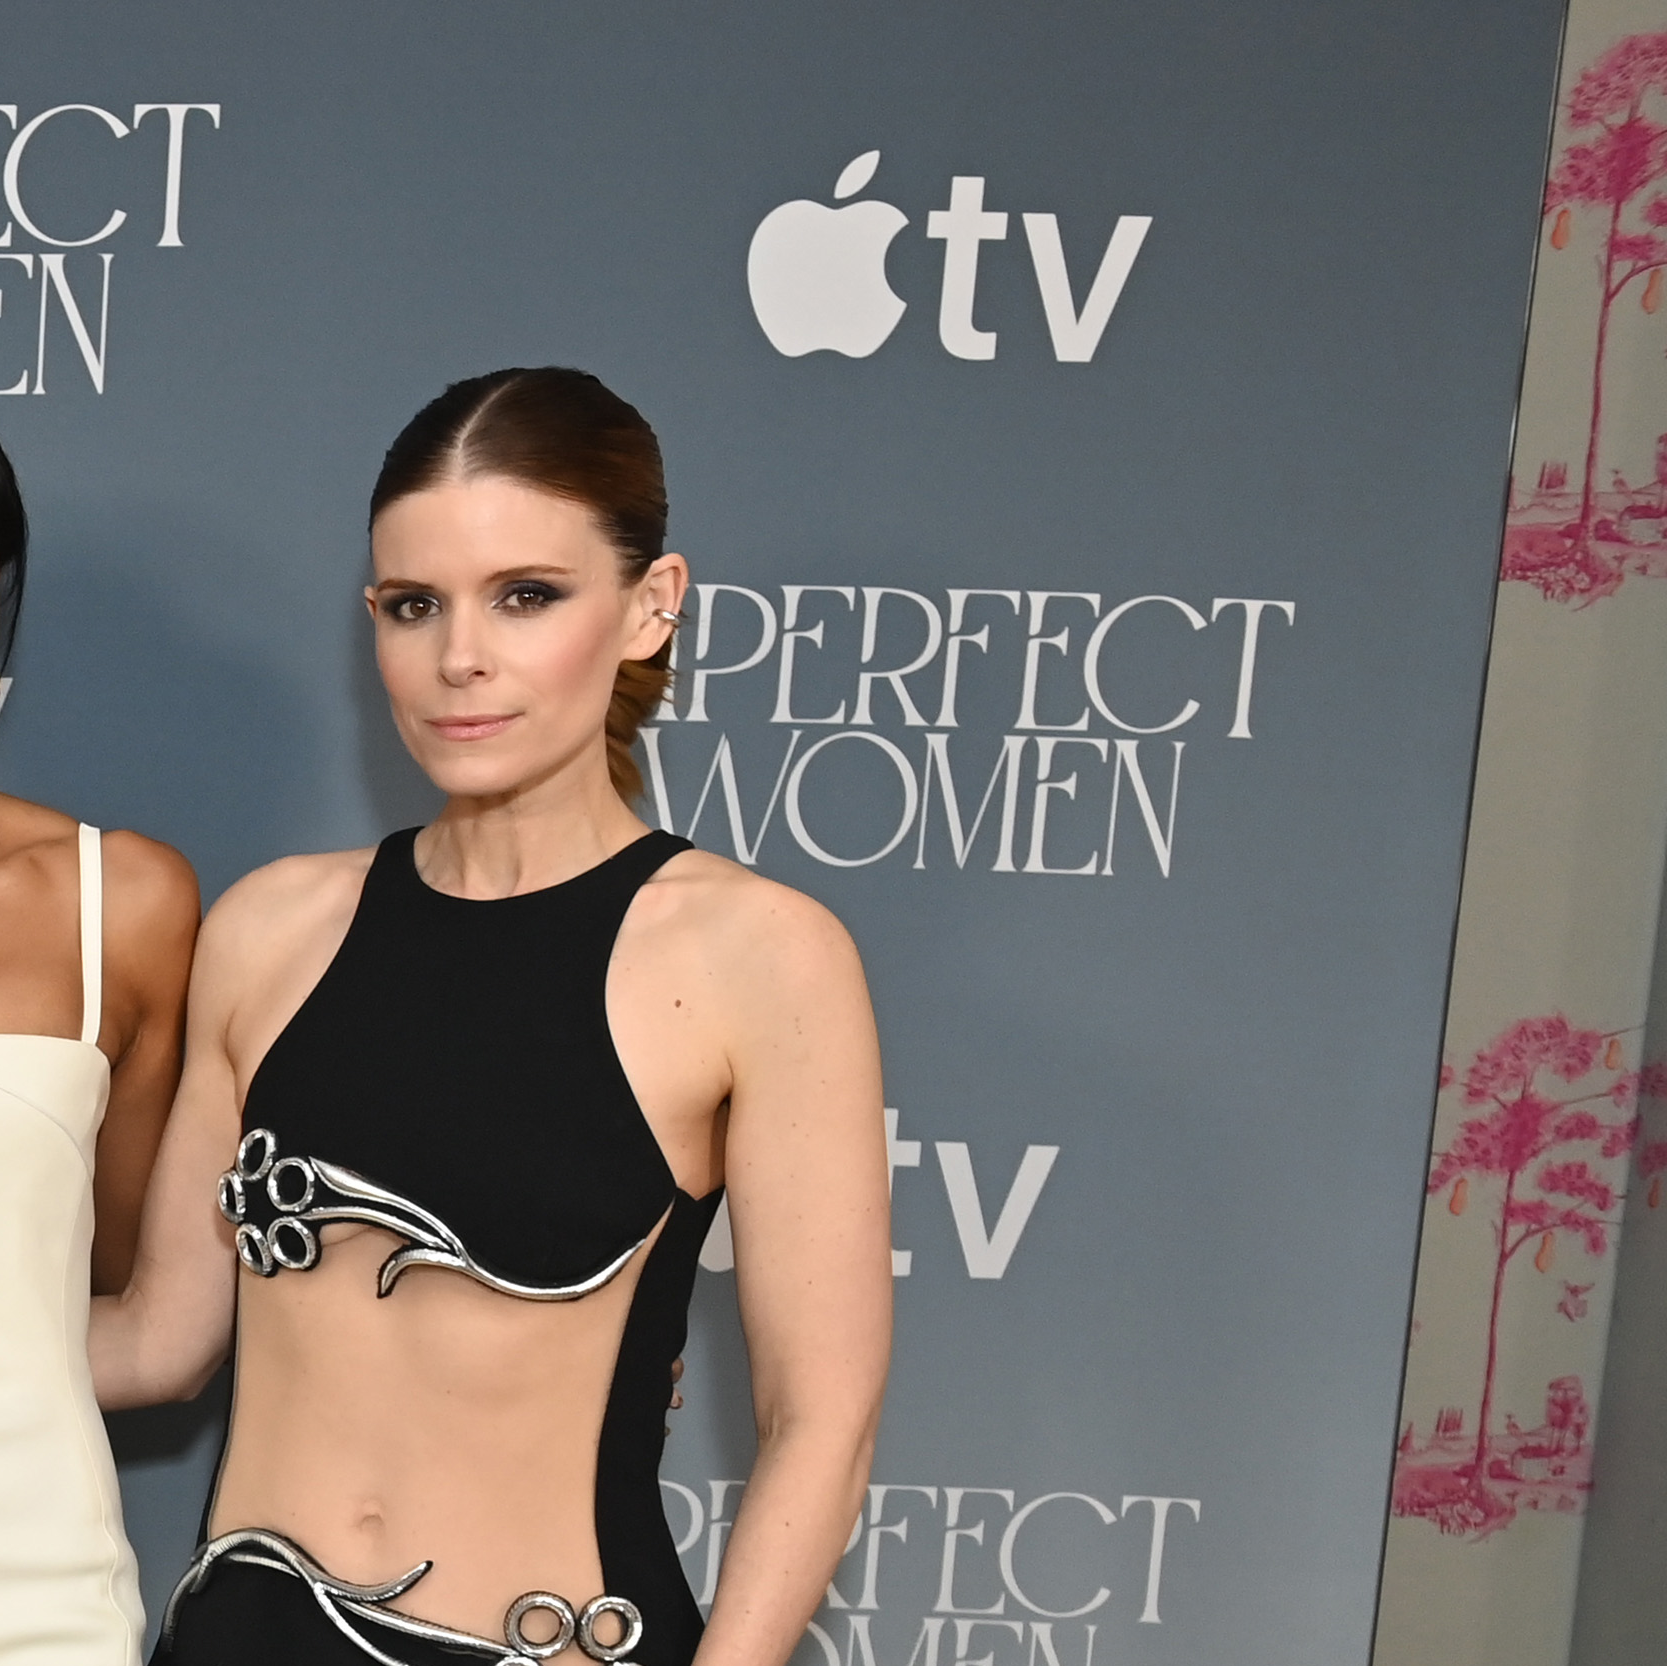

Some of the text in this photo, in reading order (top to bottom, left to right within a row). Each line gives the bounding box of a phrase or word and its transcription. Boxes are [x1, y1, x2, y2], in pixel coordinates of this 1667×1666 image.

[928, 176, 1153, 362] tv
[655, 583, 1294, 739] PERFECT
[637, 727, 1185, 878] WOMEN
